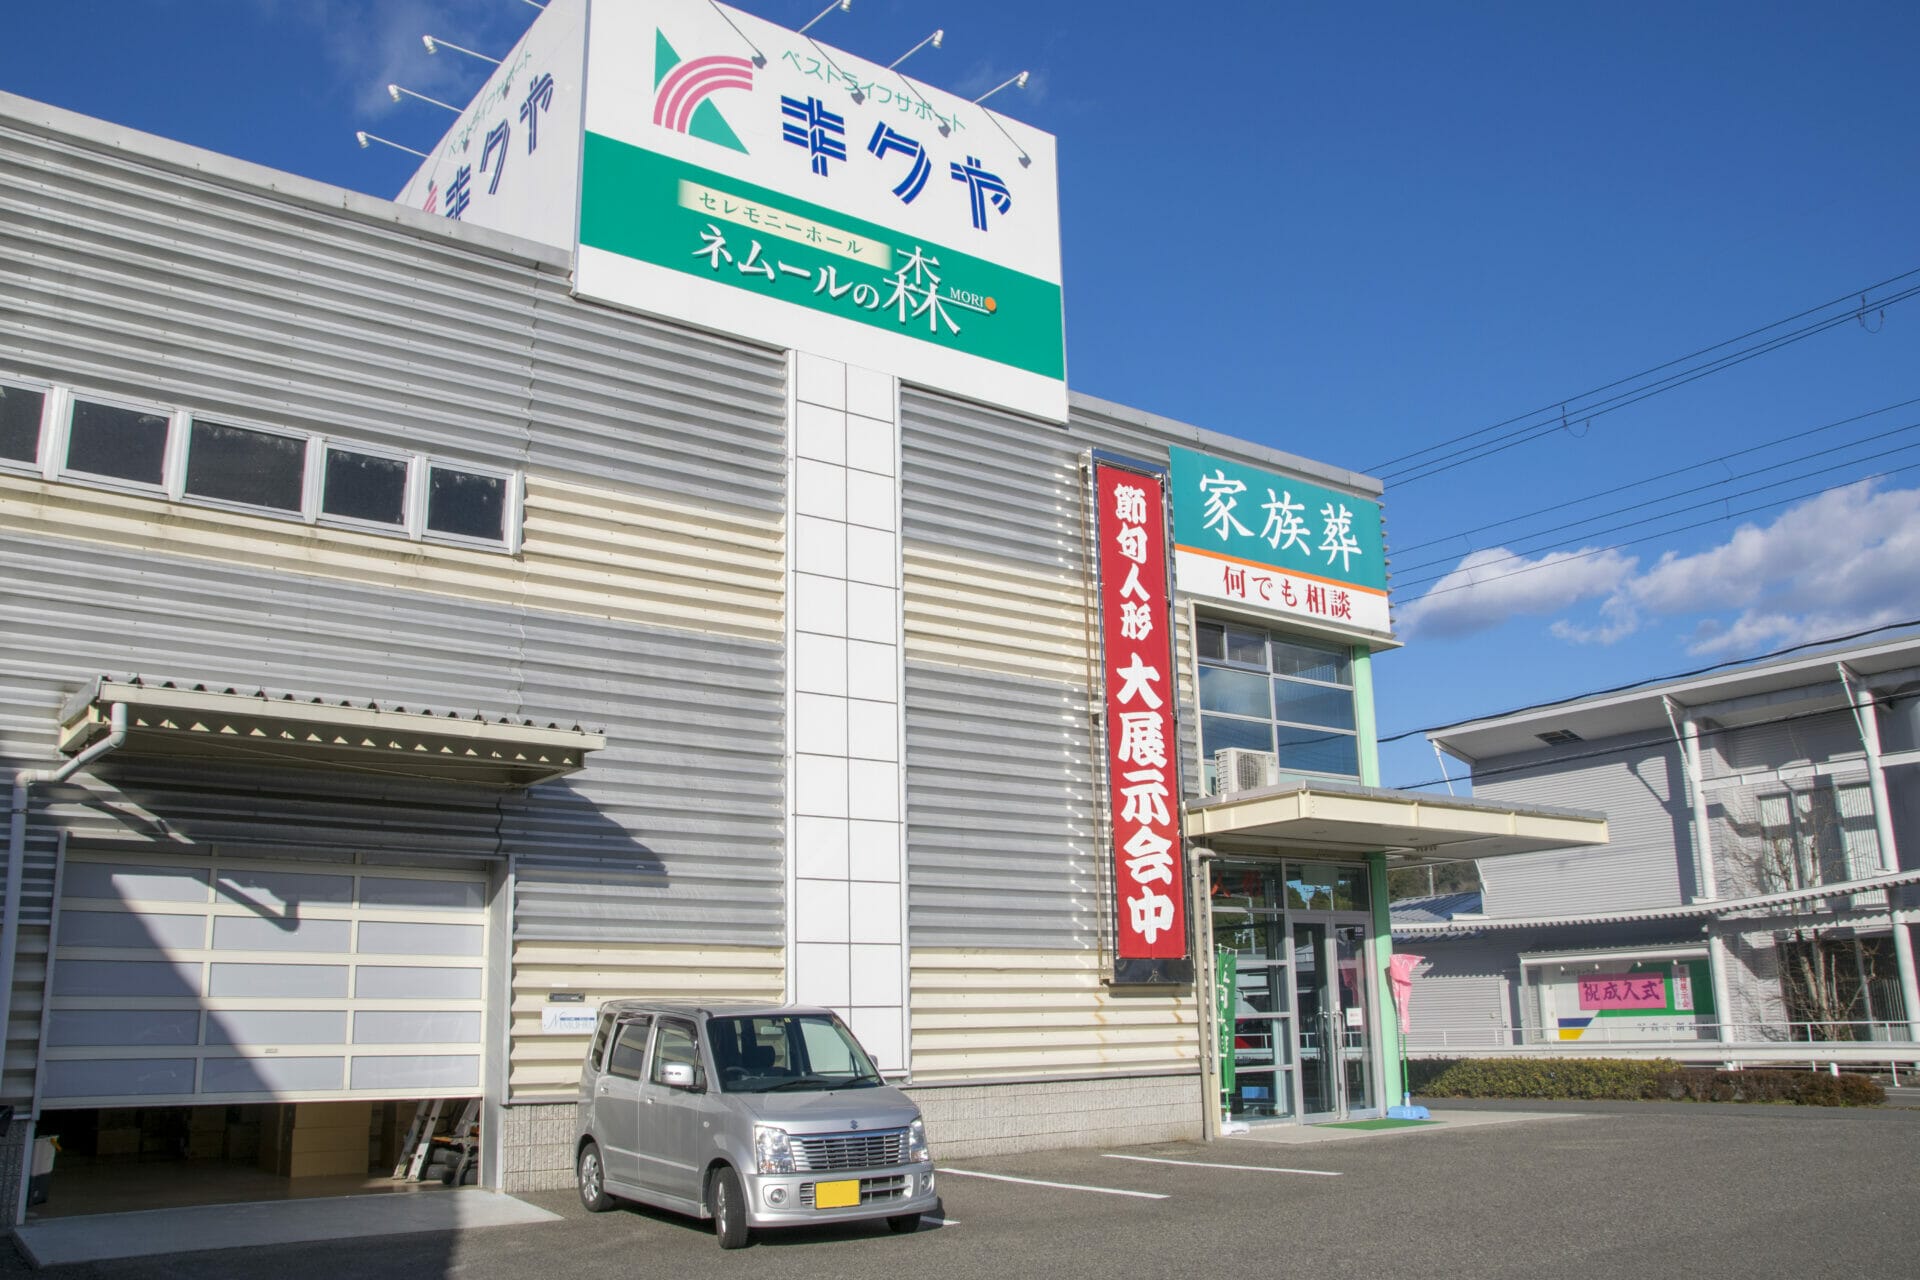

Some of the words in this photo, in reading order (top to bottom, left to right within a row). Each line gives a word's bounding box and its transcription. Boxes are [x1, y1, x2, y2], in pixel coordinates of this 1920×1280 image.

[781, 49, 967, 133] ベストライフサポート
[698, 191, 864, 255] セレモニーホール
[691, 222, 962, 336] ネムールの森
[950, 286, 985, 308] MORI
[1198, 468, 1363, 573] 家族葬
[1222, 564, 1353, 621] 何でも相談
